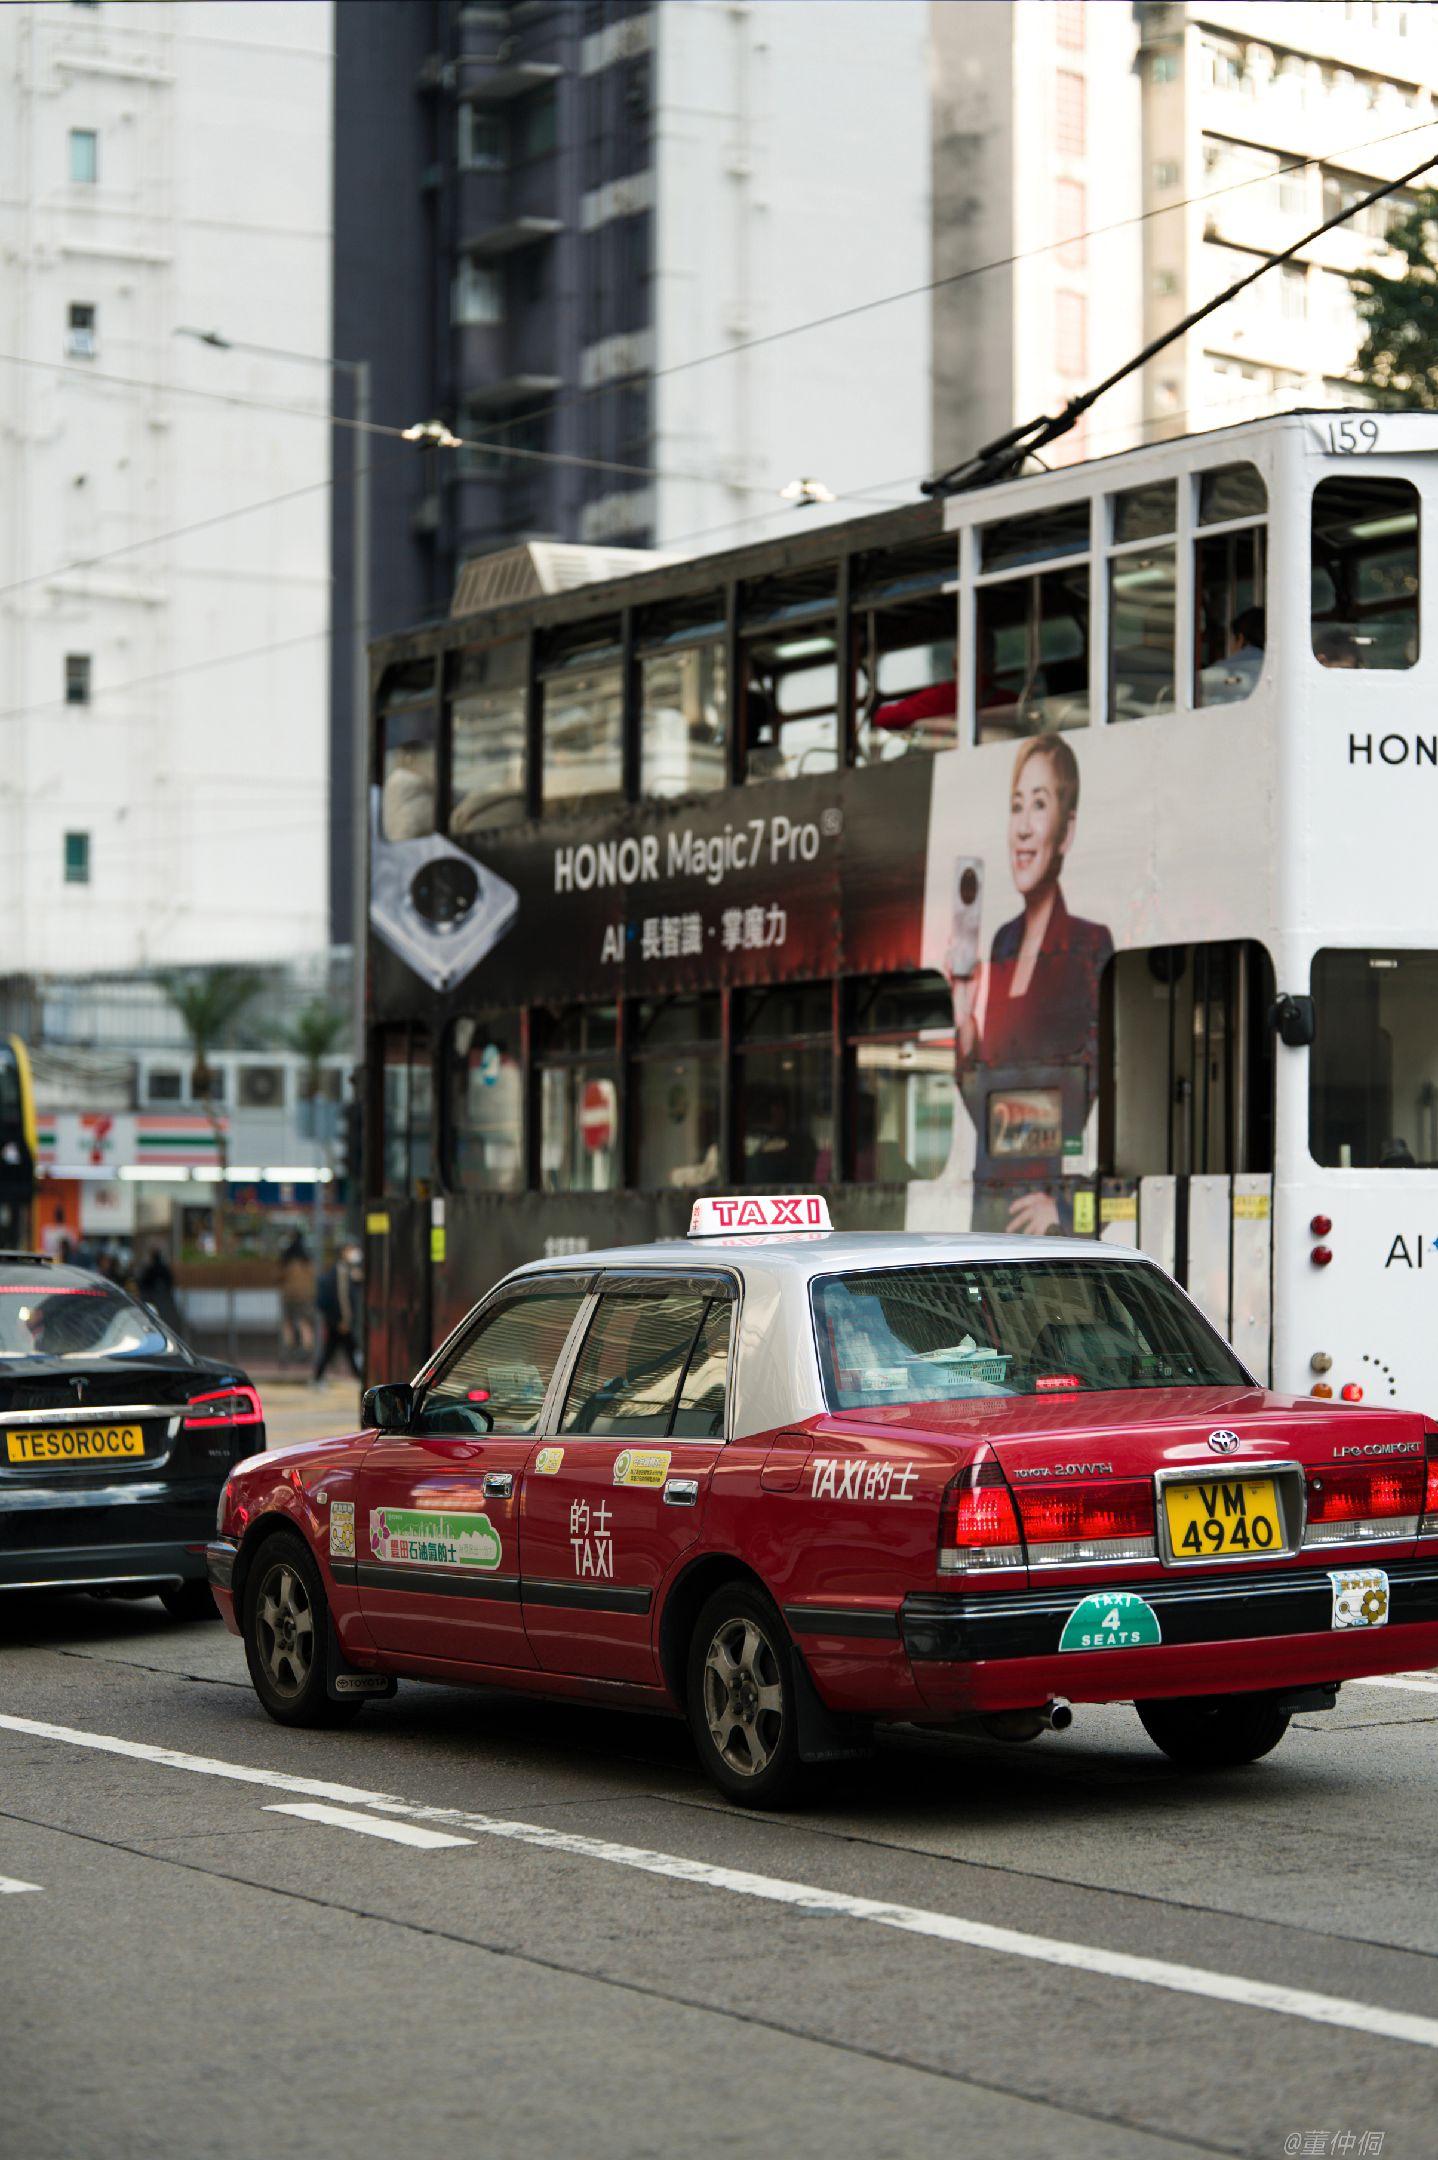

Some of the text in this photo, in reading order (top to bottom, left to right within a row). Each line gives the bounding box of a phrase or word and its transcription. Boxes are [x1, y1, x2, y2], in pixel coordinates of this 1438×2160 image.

[1327, 418, 1378, 454] 159
[1349, 733, 1438, 765] HON
[554, 834, 659, 893] HONOR
[667, 818, 766, 885] Magic7
[771, 815, 820, 864] Pro
[601, 923, 626, 964] AI
[712, 1198, 822, 1227] TAXI
[1385, 1234, 1423, 1268] AI
[1333, 1442, 1422, 1458] LPG COMFORT
[1013, 1467, 1052, 1478] TOYOTA
[1199, 1483, 1246, 1518] VM
[570, 1499, 613, 1537] 的士
[1181, 1515, 1274, 1553] 4940
[570, 1538, 614, 1578] TAXI
[1090, 1593, 1132, 1609] TAXI
[1101, 1607, 1121, 1631] 4
[1081, 1631, 1141, 1647] SEATS
[349, 1679, 386, 1688] TOYOTA
